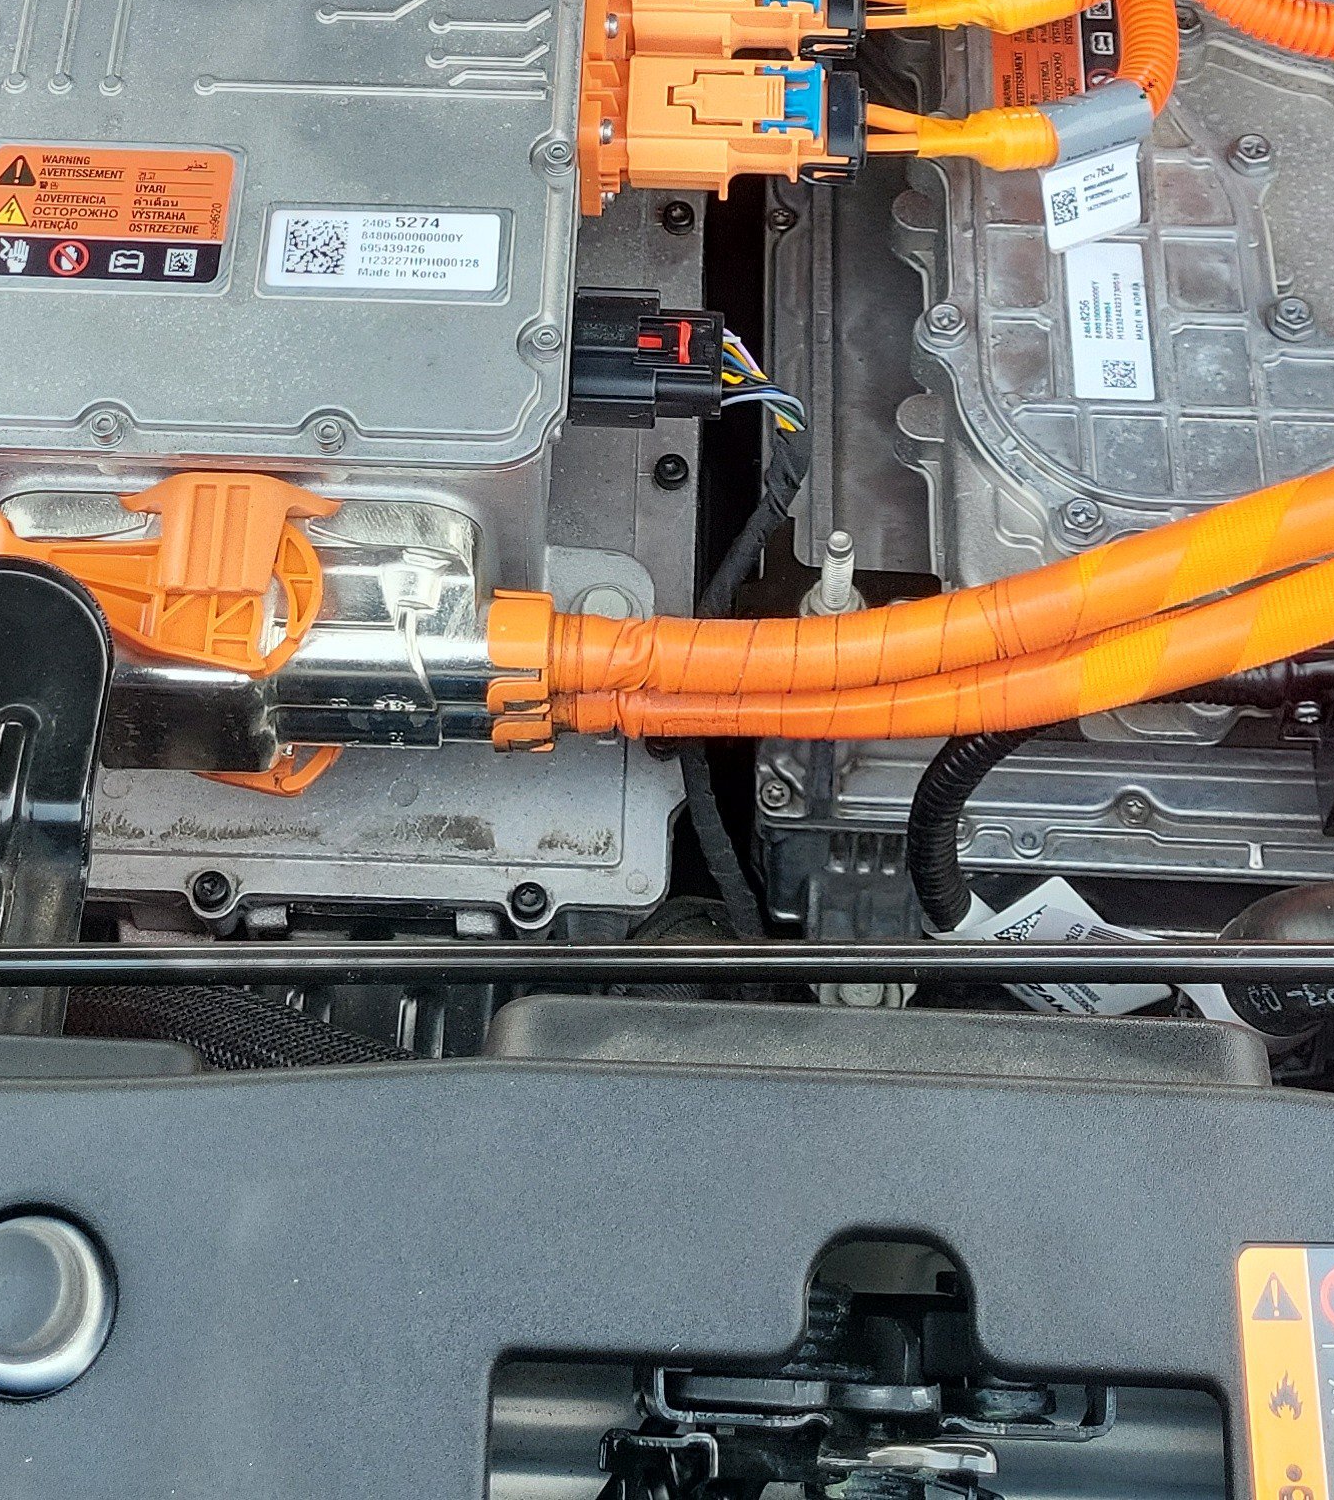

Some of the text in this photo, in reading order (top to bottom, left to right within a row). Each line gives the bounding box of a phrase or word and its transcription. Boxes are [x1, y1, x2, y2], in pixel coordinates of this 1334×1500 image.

[41, 155, 91, 166] WARNING
[39, 167, 125, 181] AVERTISSEMENT
[135, 184, 167, 194] UYARI
[35, 194, 107, 205] ADVERTENCIA
[33, 206, 119, 218] ОСТОРОЖНО
[131, 208, 186, 221] VÝSTRAHA
[29, 219, 79, 232] ATENÇÃO
[395, 216, 441, 229] 5274
[357, 268, 446, 279] Made In Korea
